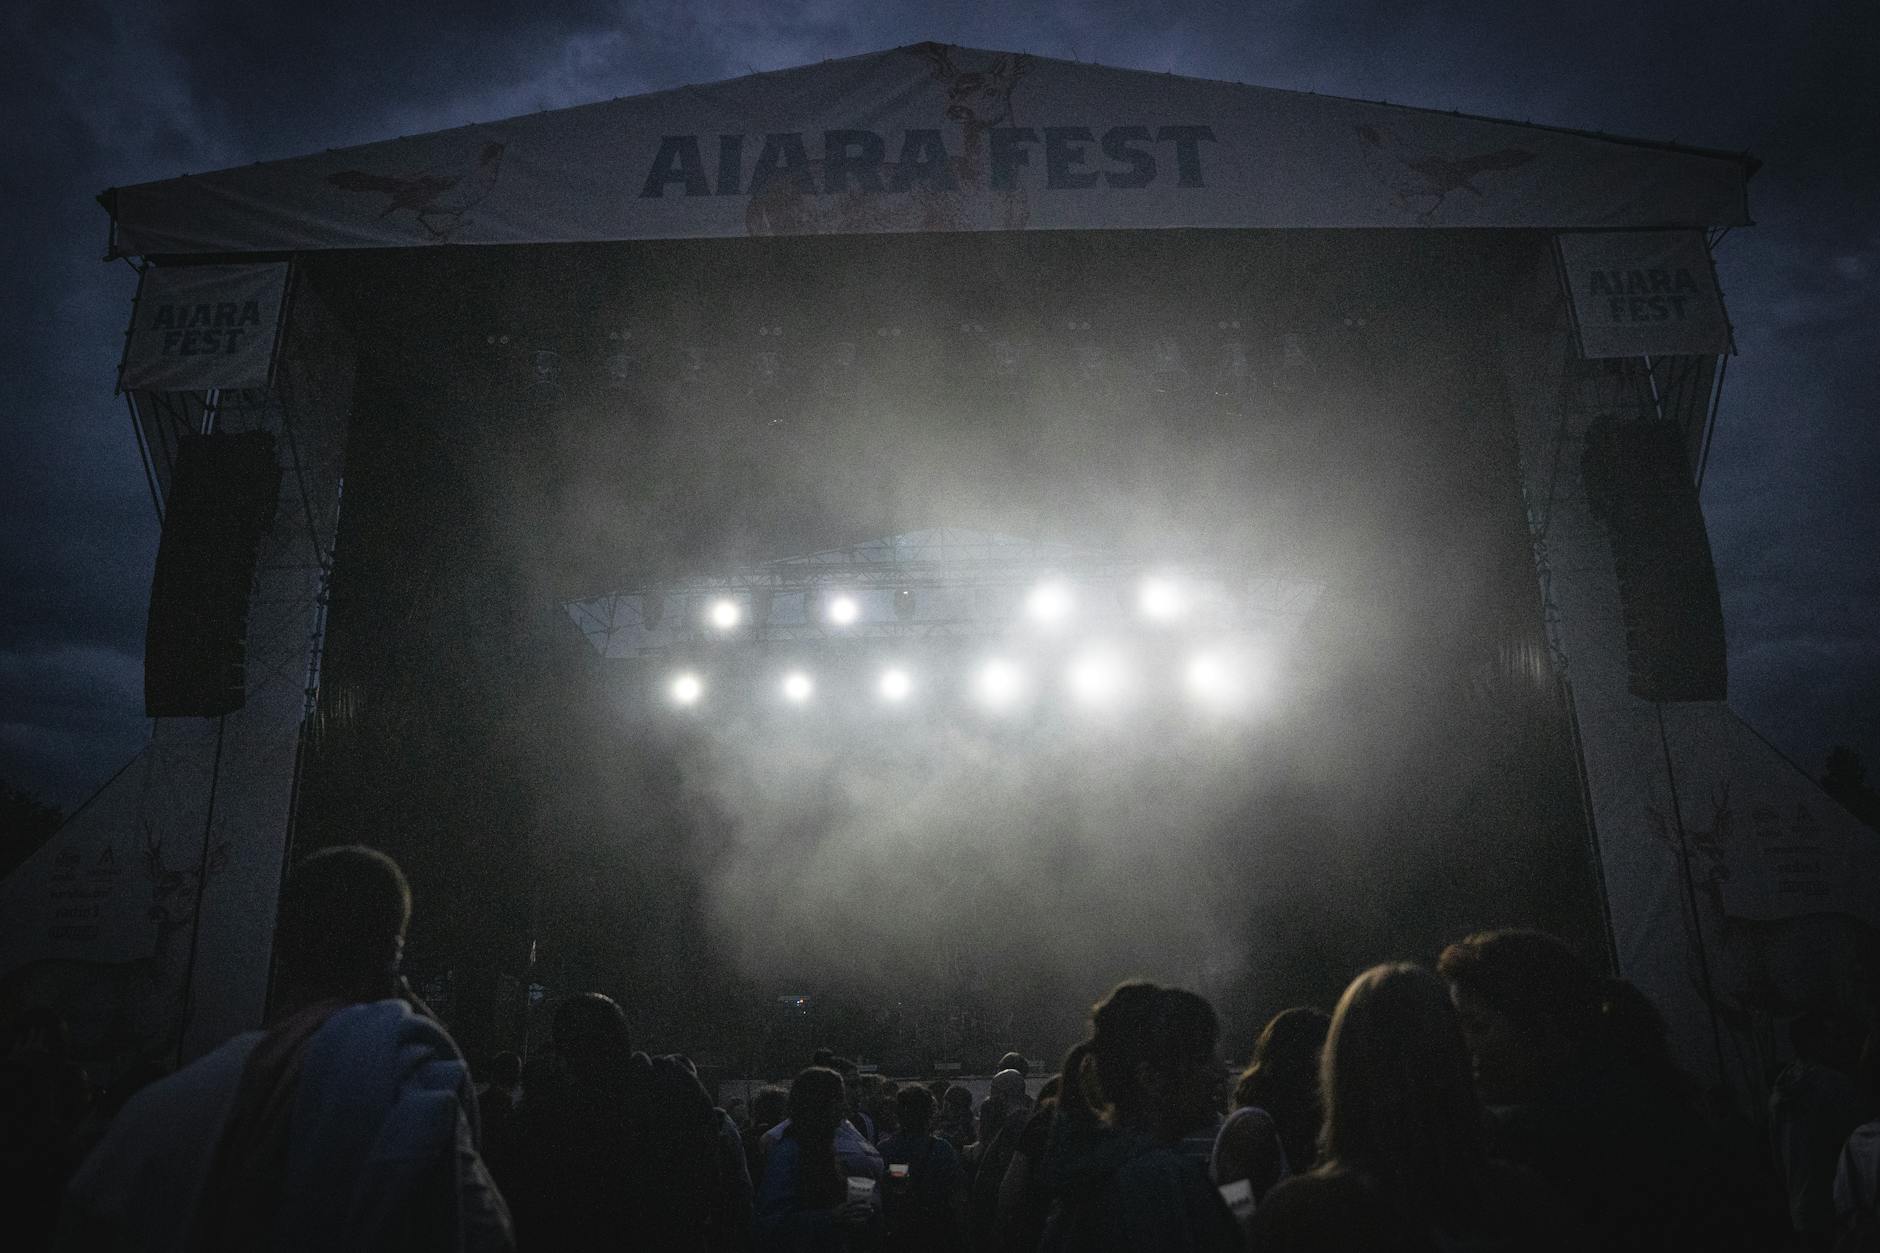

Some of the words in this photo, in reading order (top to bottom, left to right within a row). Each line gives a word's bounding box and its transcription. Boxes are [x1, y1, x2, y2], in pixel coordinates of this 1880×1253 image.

[639, 127, 958, 199] AIARA
[990, 125, 1217, 191] FEST
[1589, 269, 1699, 296] AIARA
[151, 301, 260, 330] AIARA
[1607, 295, 1687, 322] FEST
[161, 327, 244, 355] FEST
